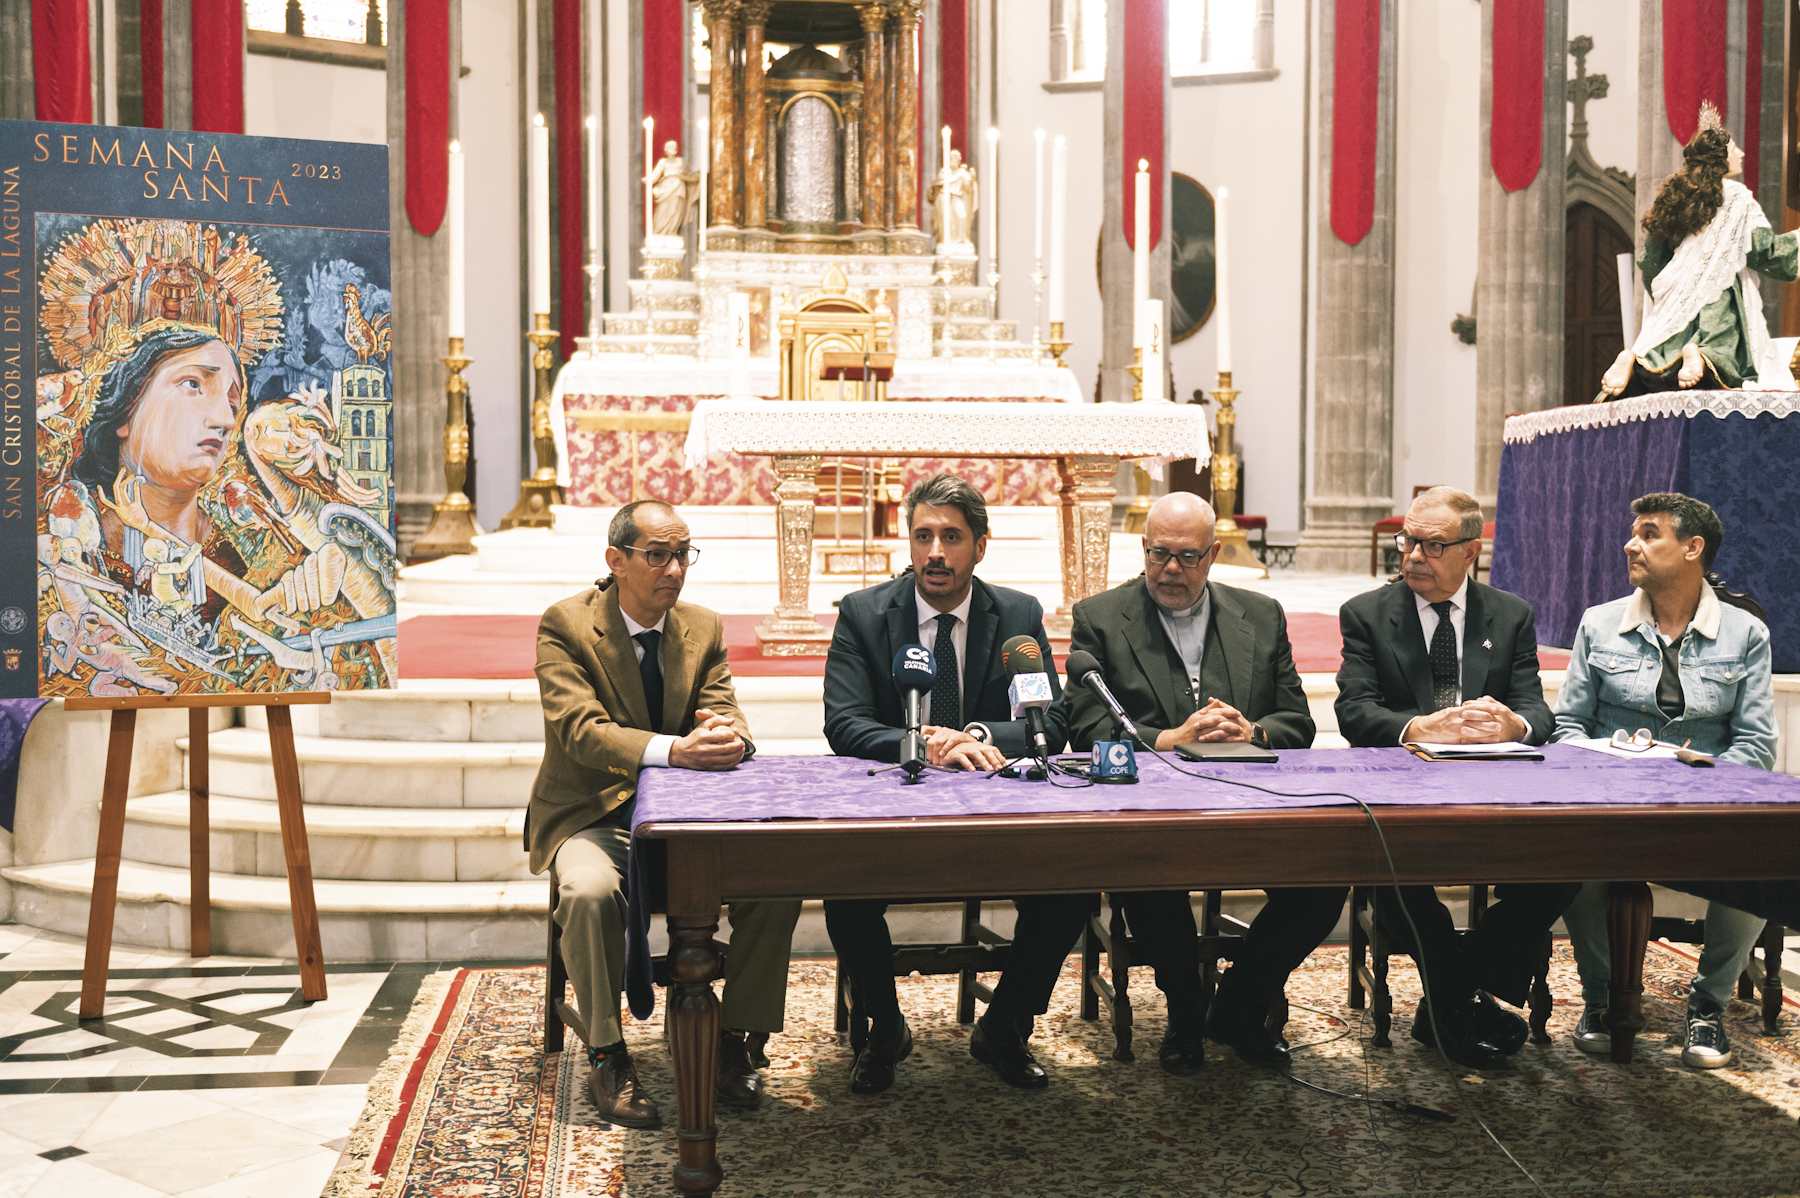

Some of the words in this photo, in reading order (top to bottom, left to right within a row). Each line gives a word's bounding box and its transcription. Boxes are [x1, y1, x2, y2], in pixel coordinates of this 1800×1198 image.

[33, 132, 230, 173] SEMANA
[143, 170, 292, 206] SANTA
[291, 163, 342, 180] 2023
[1, 165, 21, 258] LAGUNA
[1, 268, 21, 294] LA
[4, 305, 21, 332] DE
[0, 342, 22, 466] CRISTÓBAL
[3, 477, 22, 519] SAN
[1110, 766, 1129, 775] COPE
